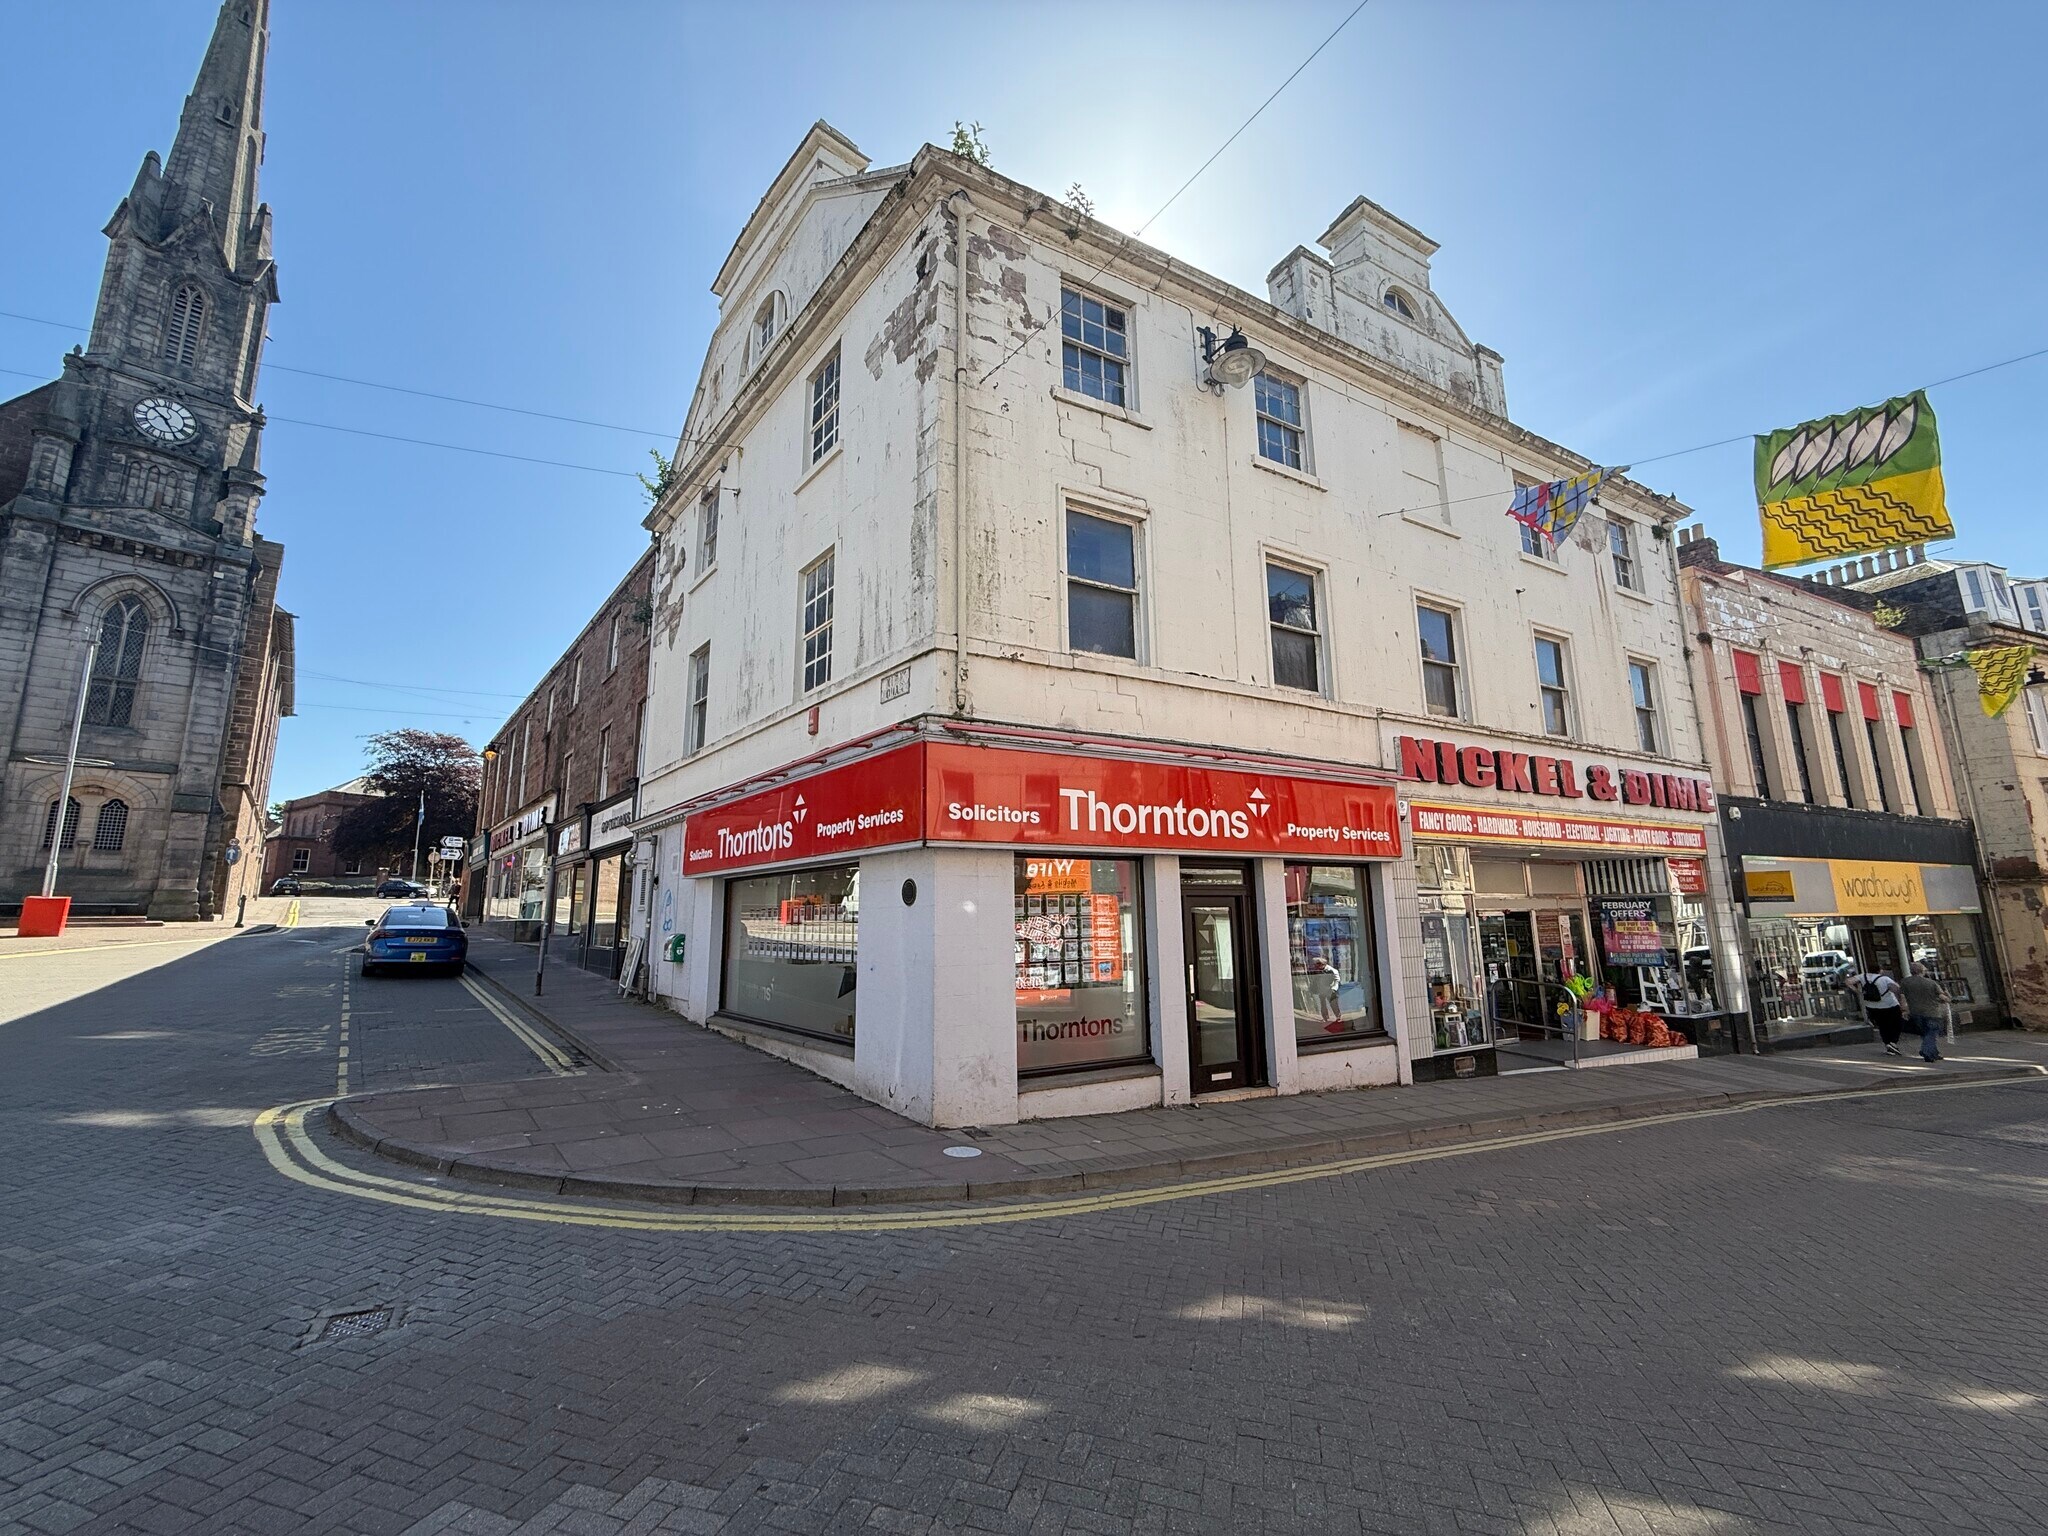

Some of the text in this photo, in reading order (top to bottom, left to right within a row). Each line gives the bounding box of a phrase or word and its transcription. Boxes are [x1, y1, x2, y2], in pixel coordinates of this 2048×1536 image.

[1395, 735, 1717, 813] NICKEL & DIME
[817, 808, 904, 838] Property Services
[948, 788, 1390, 843] Solicitors Thorntons Property Services
[1418, 811, 1702, 848] FANCY GOODS HARDWARE HOUSEHOLD ELECTRICAL LIGHTING PARTY GOODS STATIONERY
[689, 819, 793, 862] Solicitors Thorntons
[1842, 867, 1918, 903] wardhaugh
[1602, 901, 1651, 910] FEBRUARY
[1610, 910, 1647, 918] OFFERS
[1017, 1015, 1124, 1042] Thorntons
